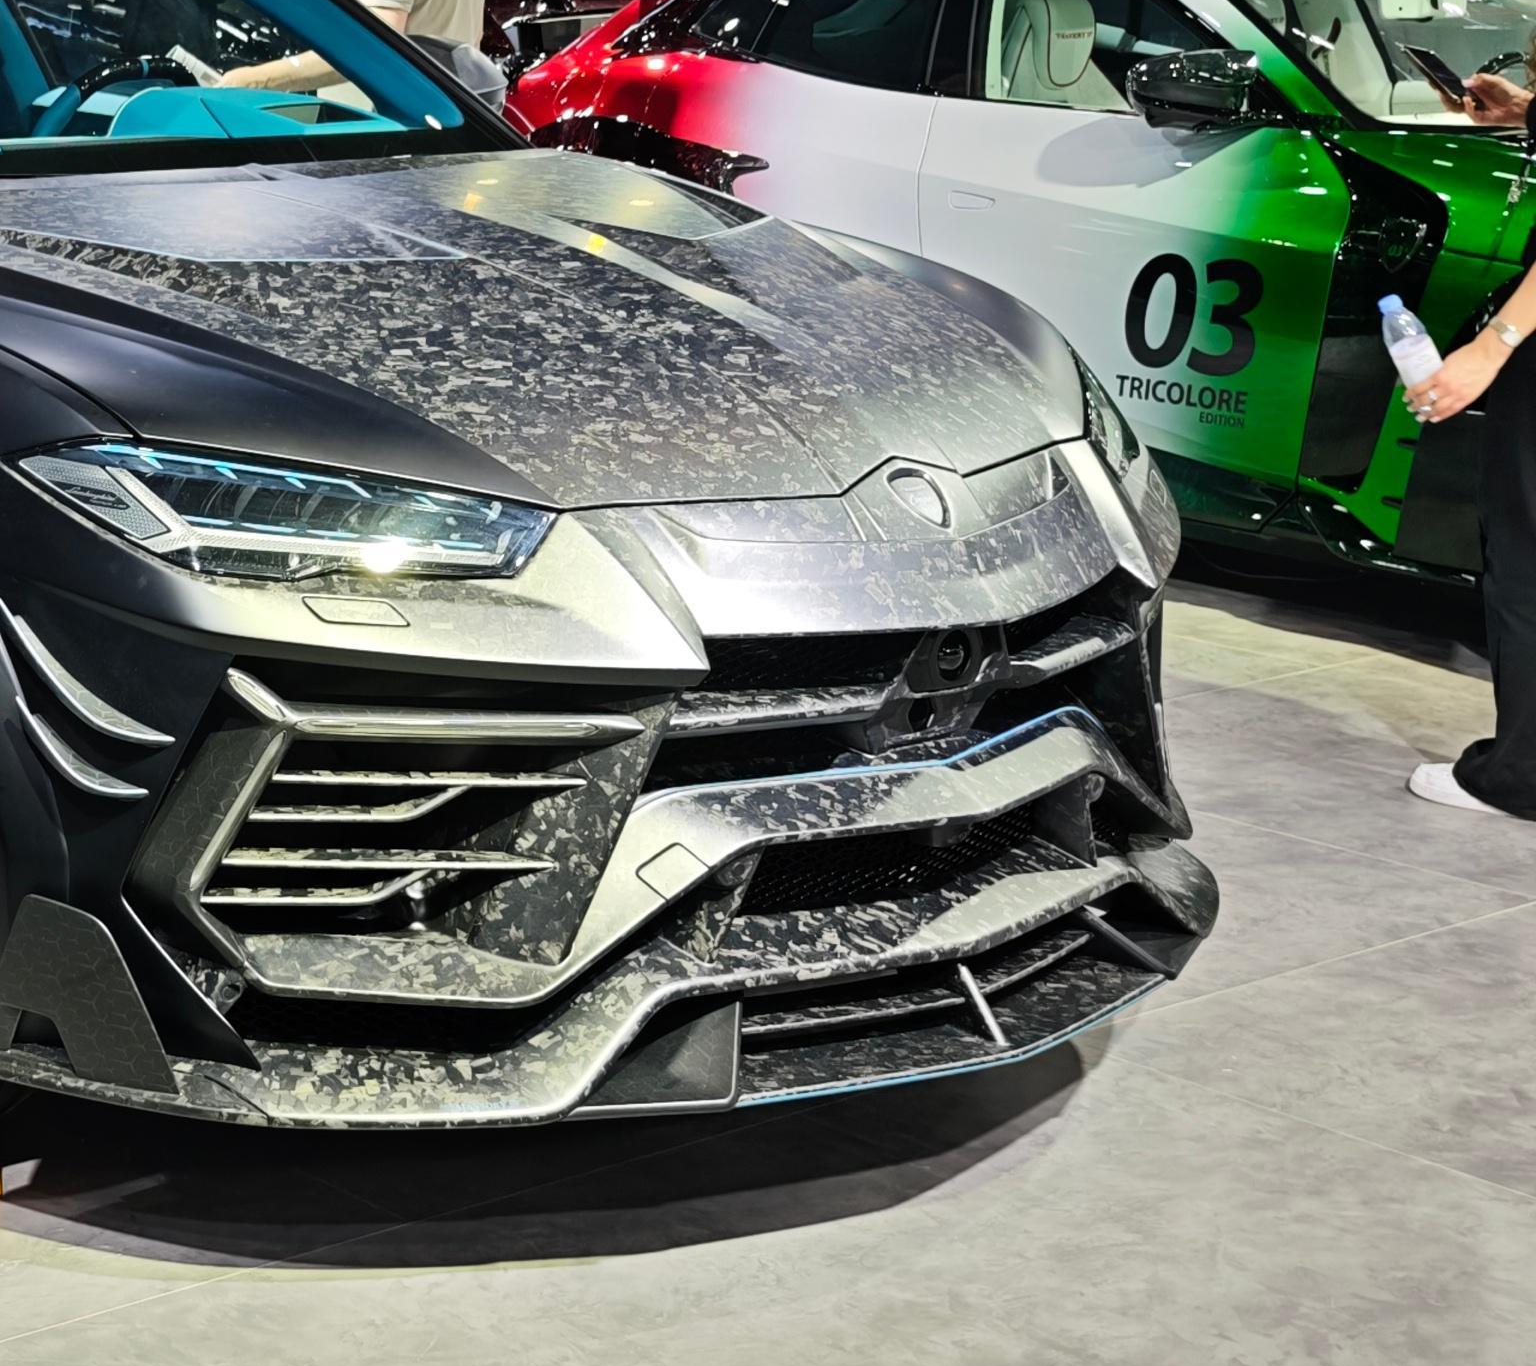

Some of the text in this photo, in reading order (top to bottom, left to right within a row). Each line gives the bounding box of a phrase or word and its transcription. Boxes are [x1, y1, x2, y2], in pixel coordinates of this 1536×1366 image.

[1124, 252, 1264, 376] 03
[1115, 374, 1249, 415] TRICOLORE
[1198, 412, 1246, 428] EDITION
